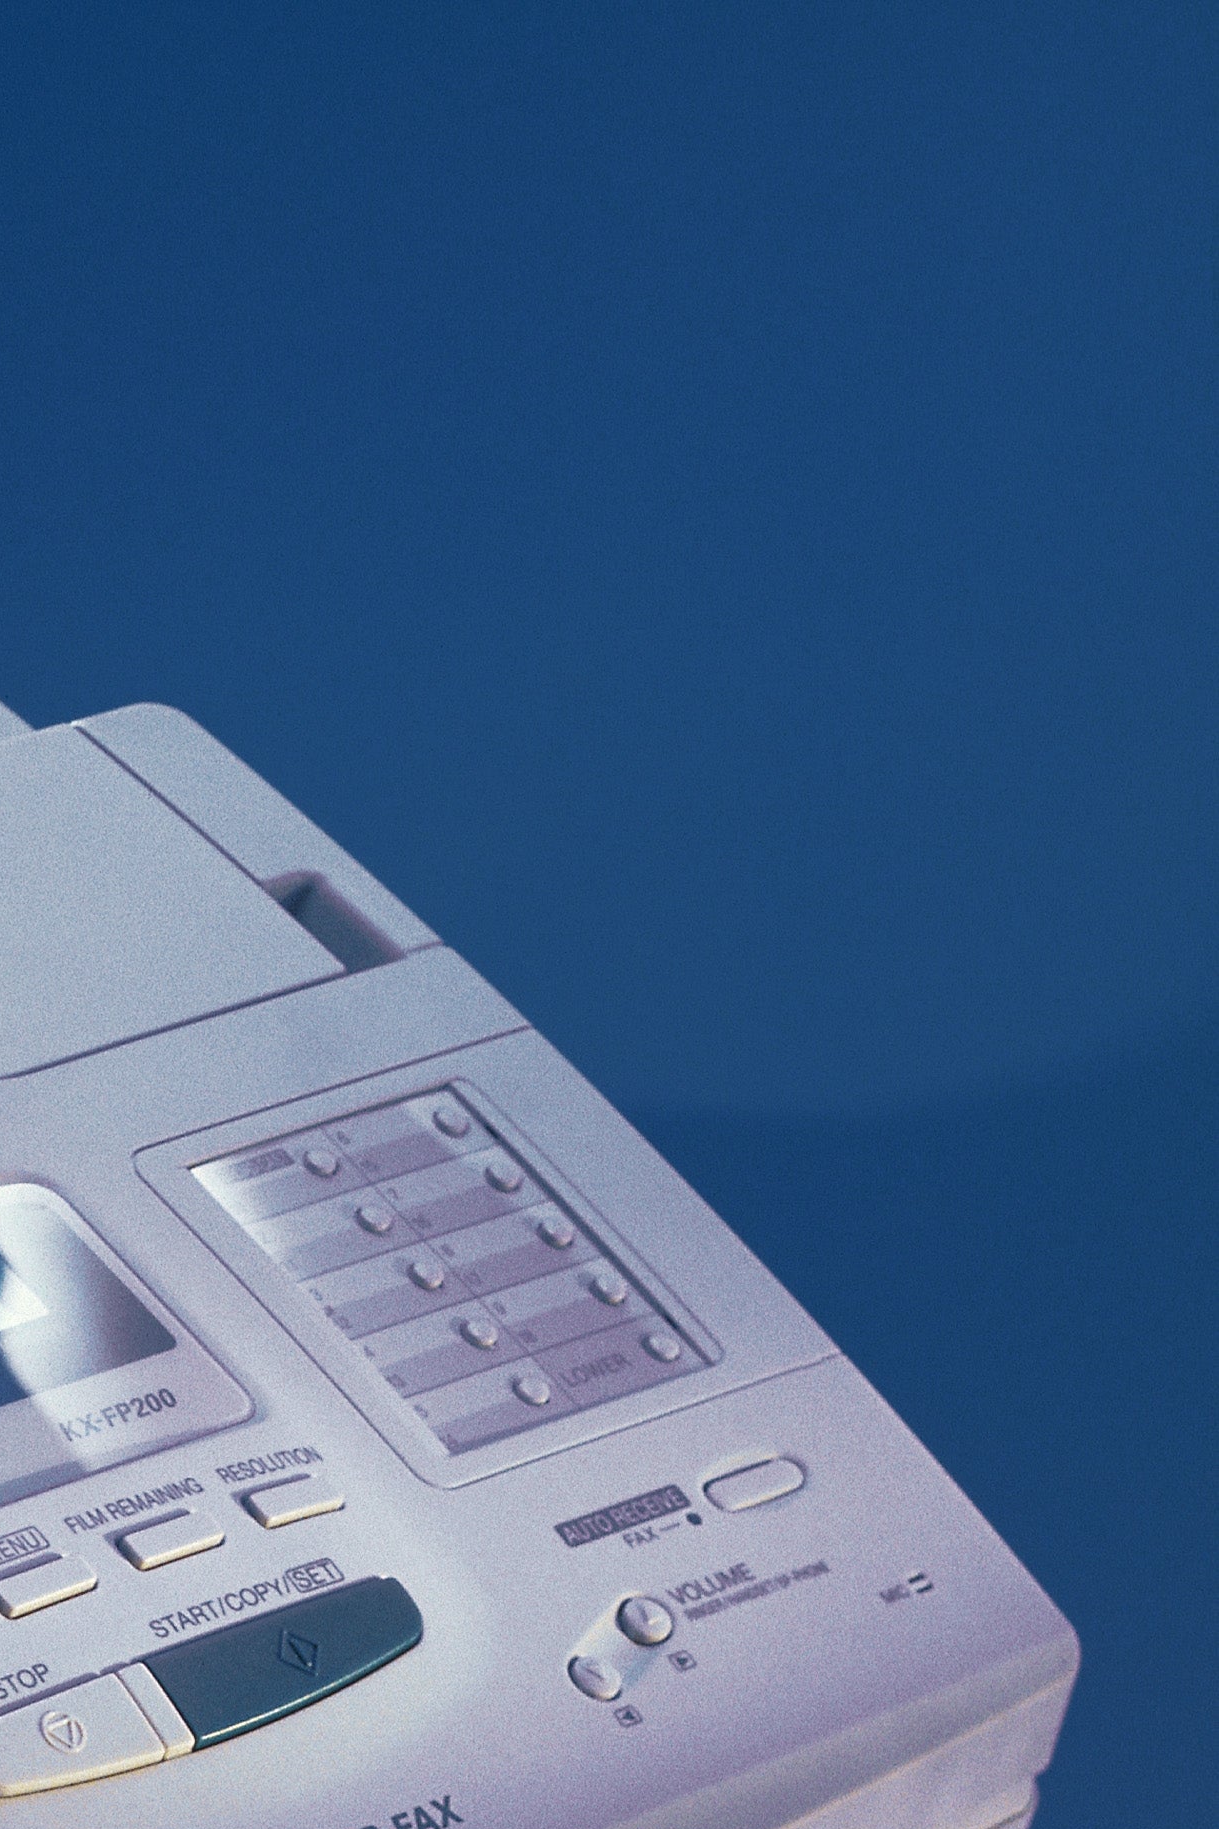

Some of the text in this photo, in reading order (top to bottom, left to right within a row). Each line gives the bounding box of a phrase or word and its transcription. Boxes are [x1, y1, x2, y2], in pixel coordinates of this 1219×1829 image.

[558, 1353, 630, 1388] LOWER
[59, 1386, 179, 1443] KX-FP200
[216, 1446, 324, 1484] RESOLUTION
[65, 1477, 204, 1536] FILM REMAINING
[564, 1485, 685, 1544] AUTO RECEIVE
[622, 1525, 660, 1549] FAX
[667, 1561, 757, 1605] VOLUME
